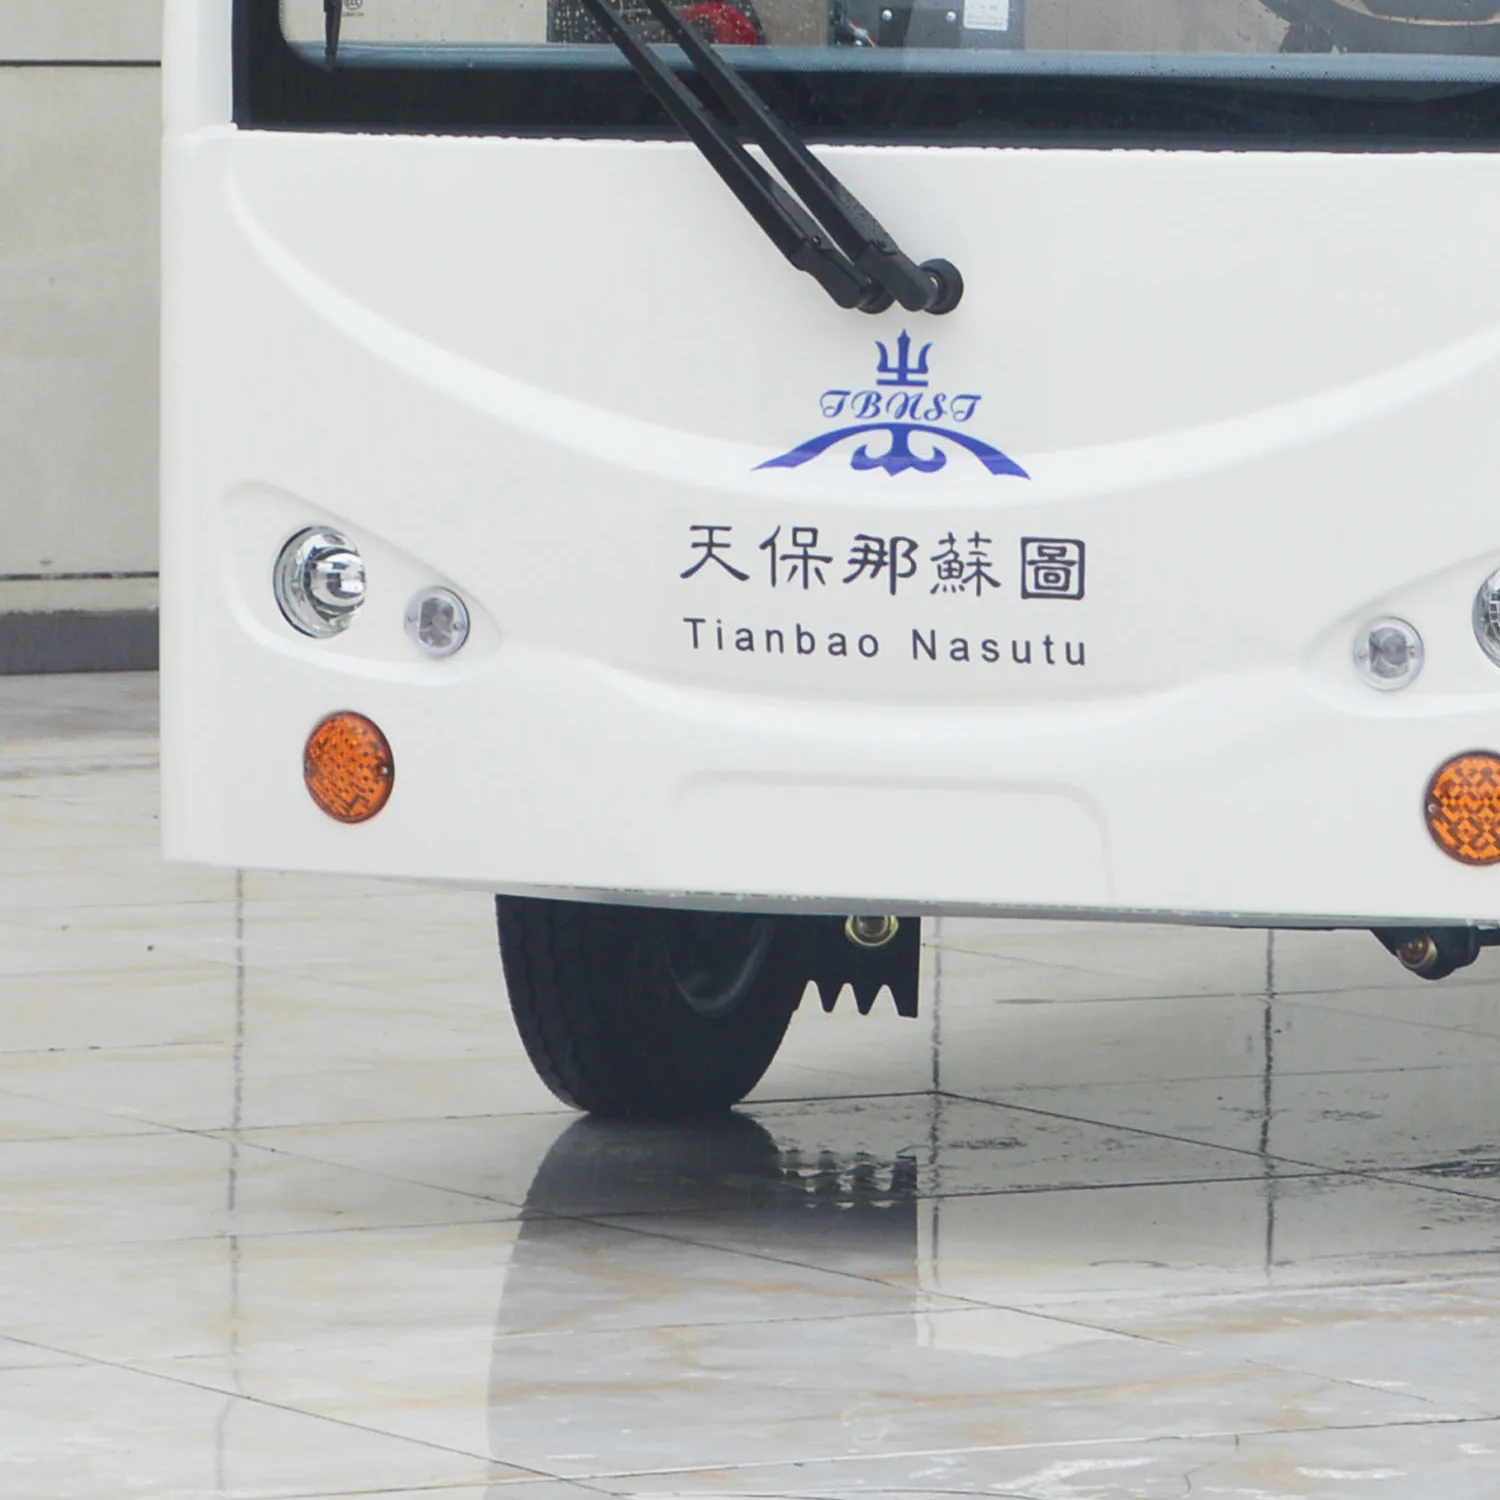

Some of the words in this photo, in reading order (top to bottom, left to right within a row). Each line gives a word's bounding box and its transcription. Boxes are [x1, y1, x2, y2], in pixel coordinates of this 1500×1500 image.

[680, 524, 1087, 601] 天保那蘇圖
[682, 617, 880, 658] Tianbao
[911, 628, 1087, 667] Nasutu
